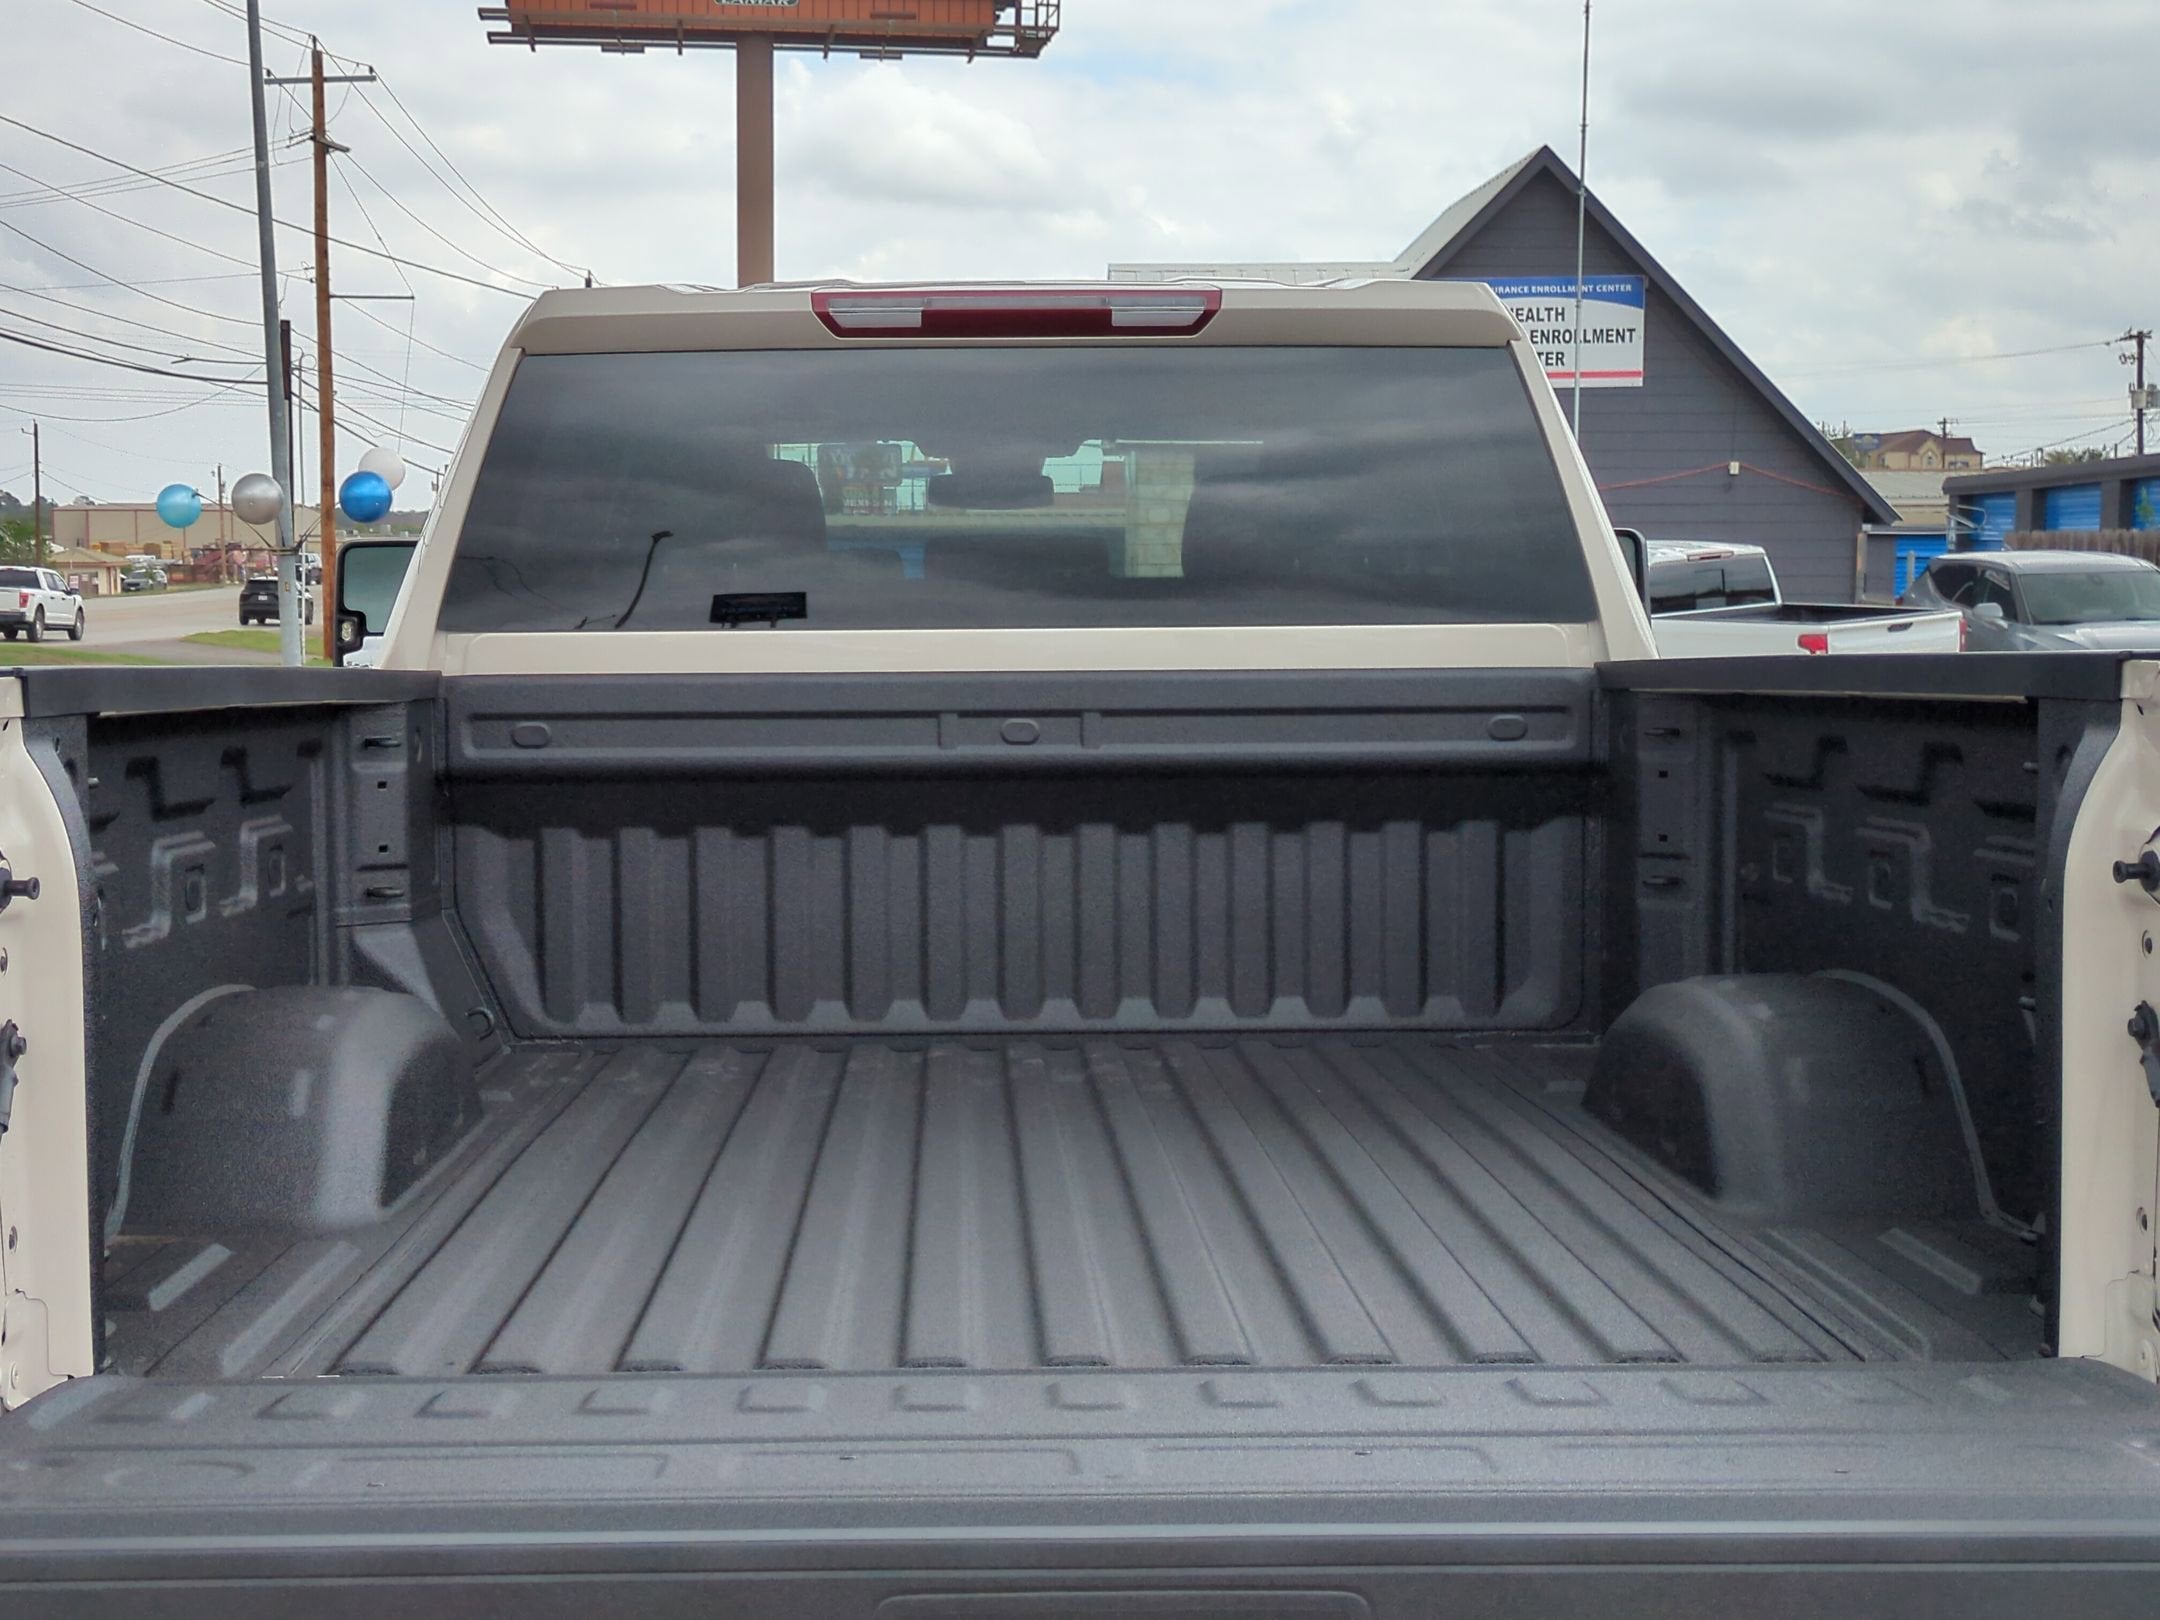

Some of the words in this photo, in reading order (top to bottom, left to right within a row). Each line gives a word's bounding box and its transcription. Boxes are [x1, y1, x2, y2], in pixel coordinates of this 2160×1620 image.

[1531, 285, 1593, 294] ENROLLMNT
[1596, 284, 1632, 292] CENTER
[1510, 307, 1565, 322] EALTH
